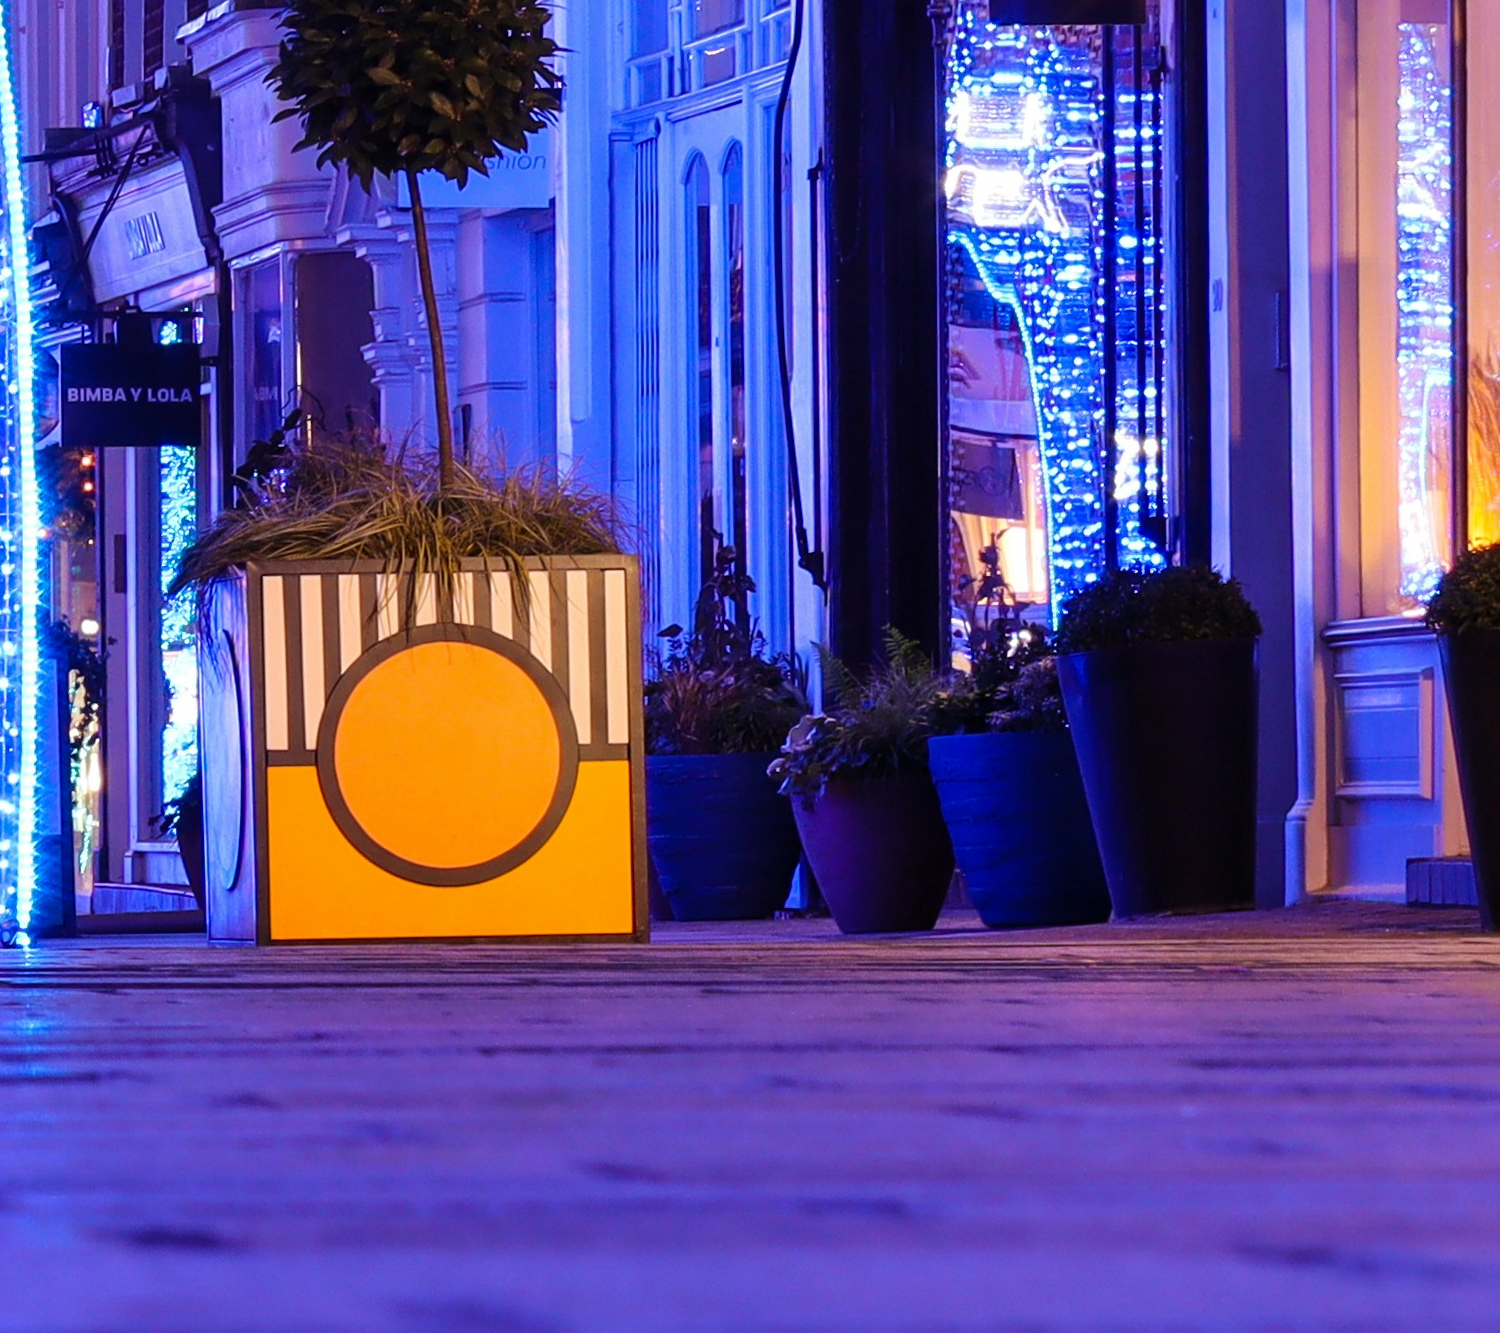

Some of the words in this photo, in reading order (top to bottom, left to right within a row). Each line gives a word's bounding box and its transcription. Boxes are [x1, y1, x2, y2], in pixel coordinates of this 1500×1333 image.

[67, 387, 127, 402] BIMBA
[130, 387, 142, 402] Y
[147, 388, 193, 402] LOLA
